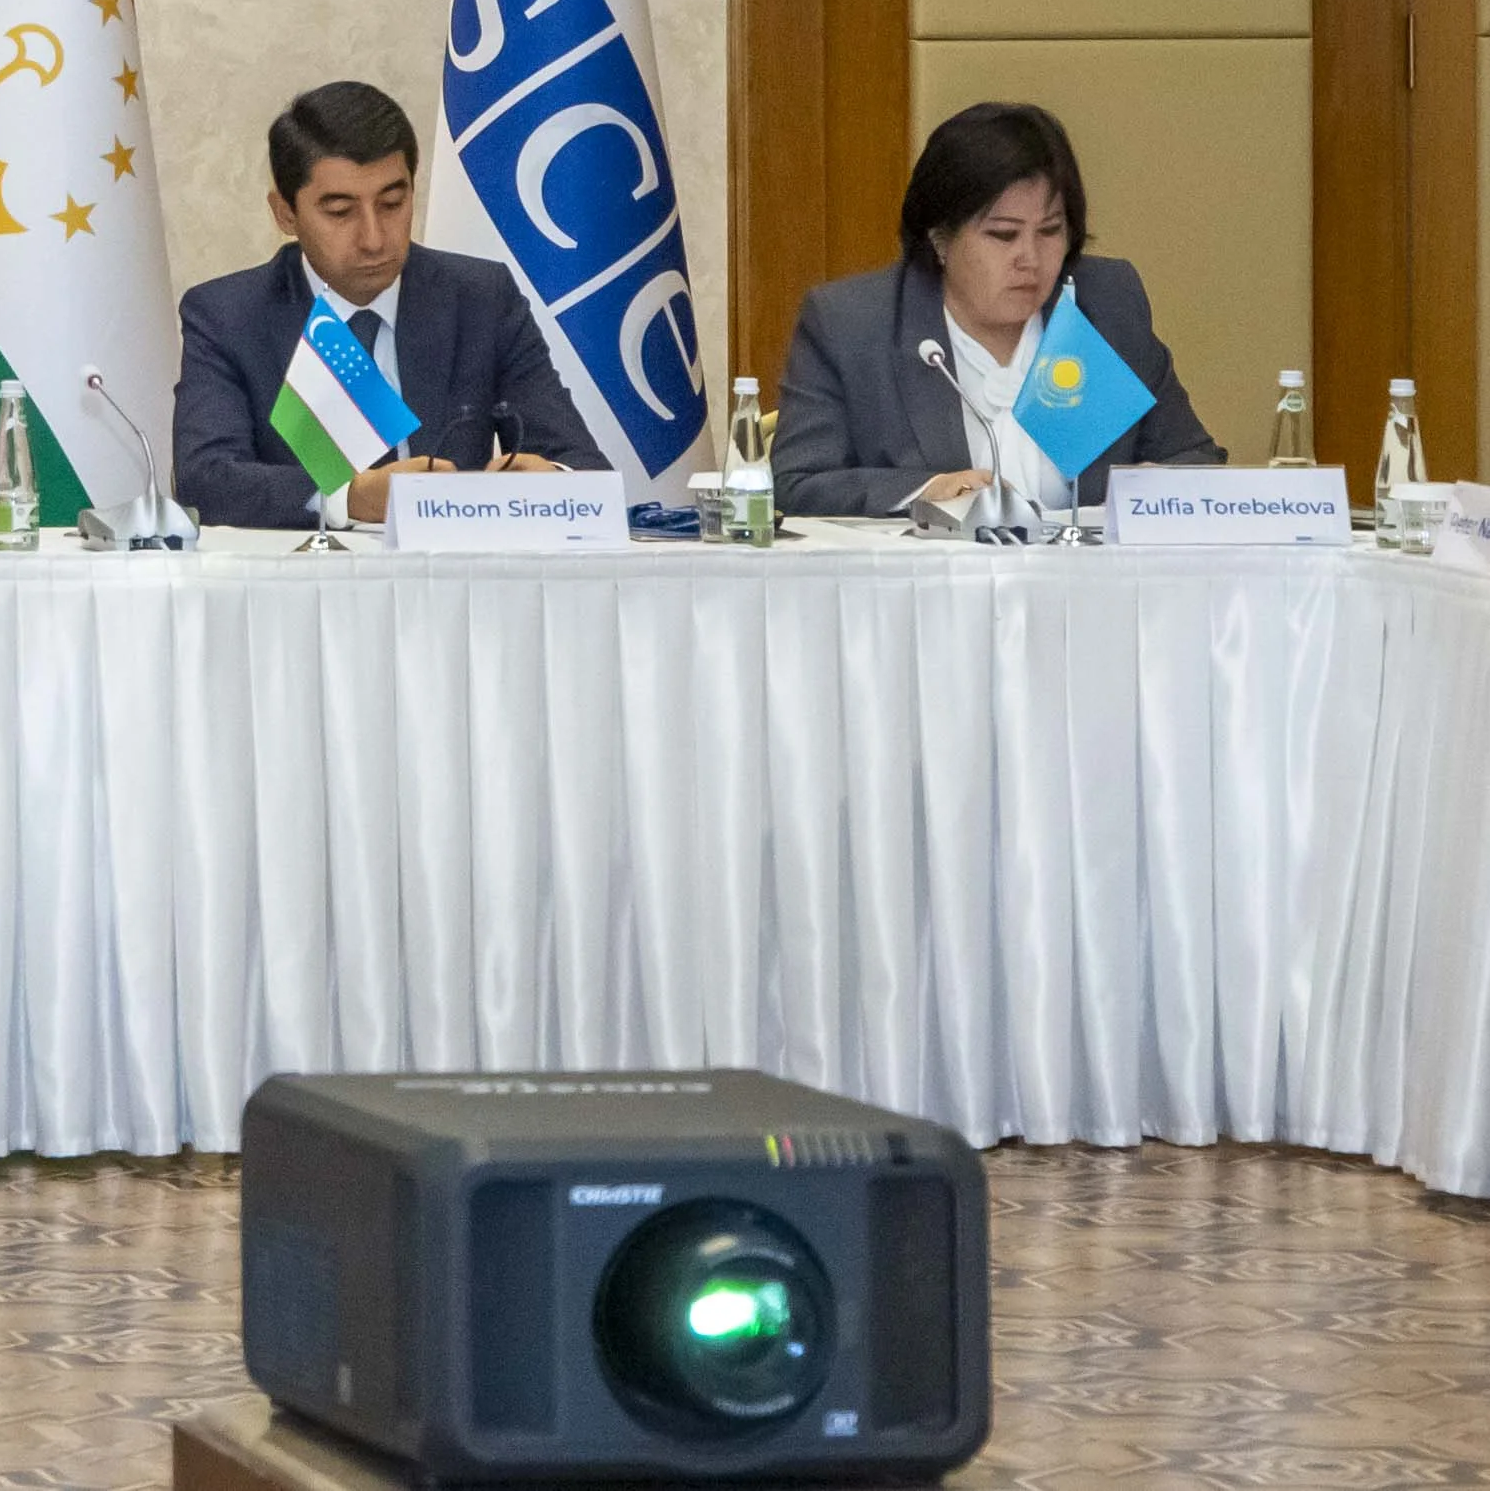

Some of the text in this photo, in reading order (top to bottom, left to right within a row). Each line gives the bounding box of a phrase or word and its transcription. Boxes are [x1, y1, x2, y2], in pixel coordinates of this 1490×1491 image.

[417, 499, 603, 521] Ilkhom Siradjev
[1130, 498, 1336, 515] Zulfia Torebekova
